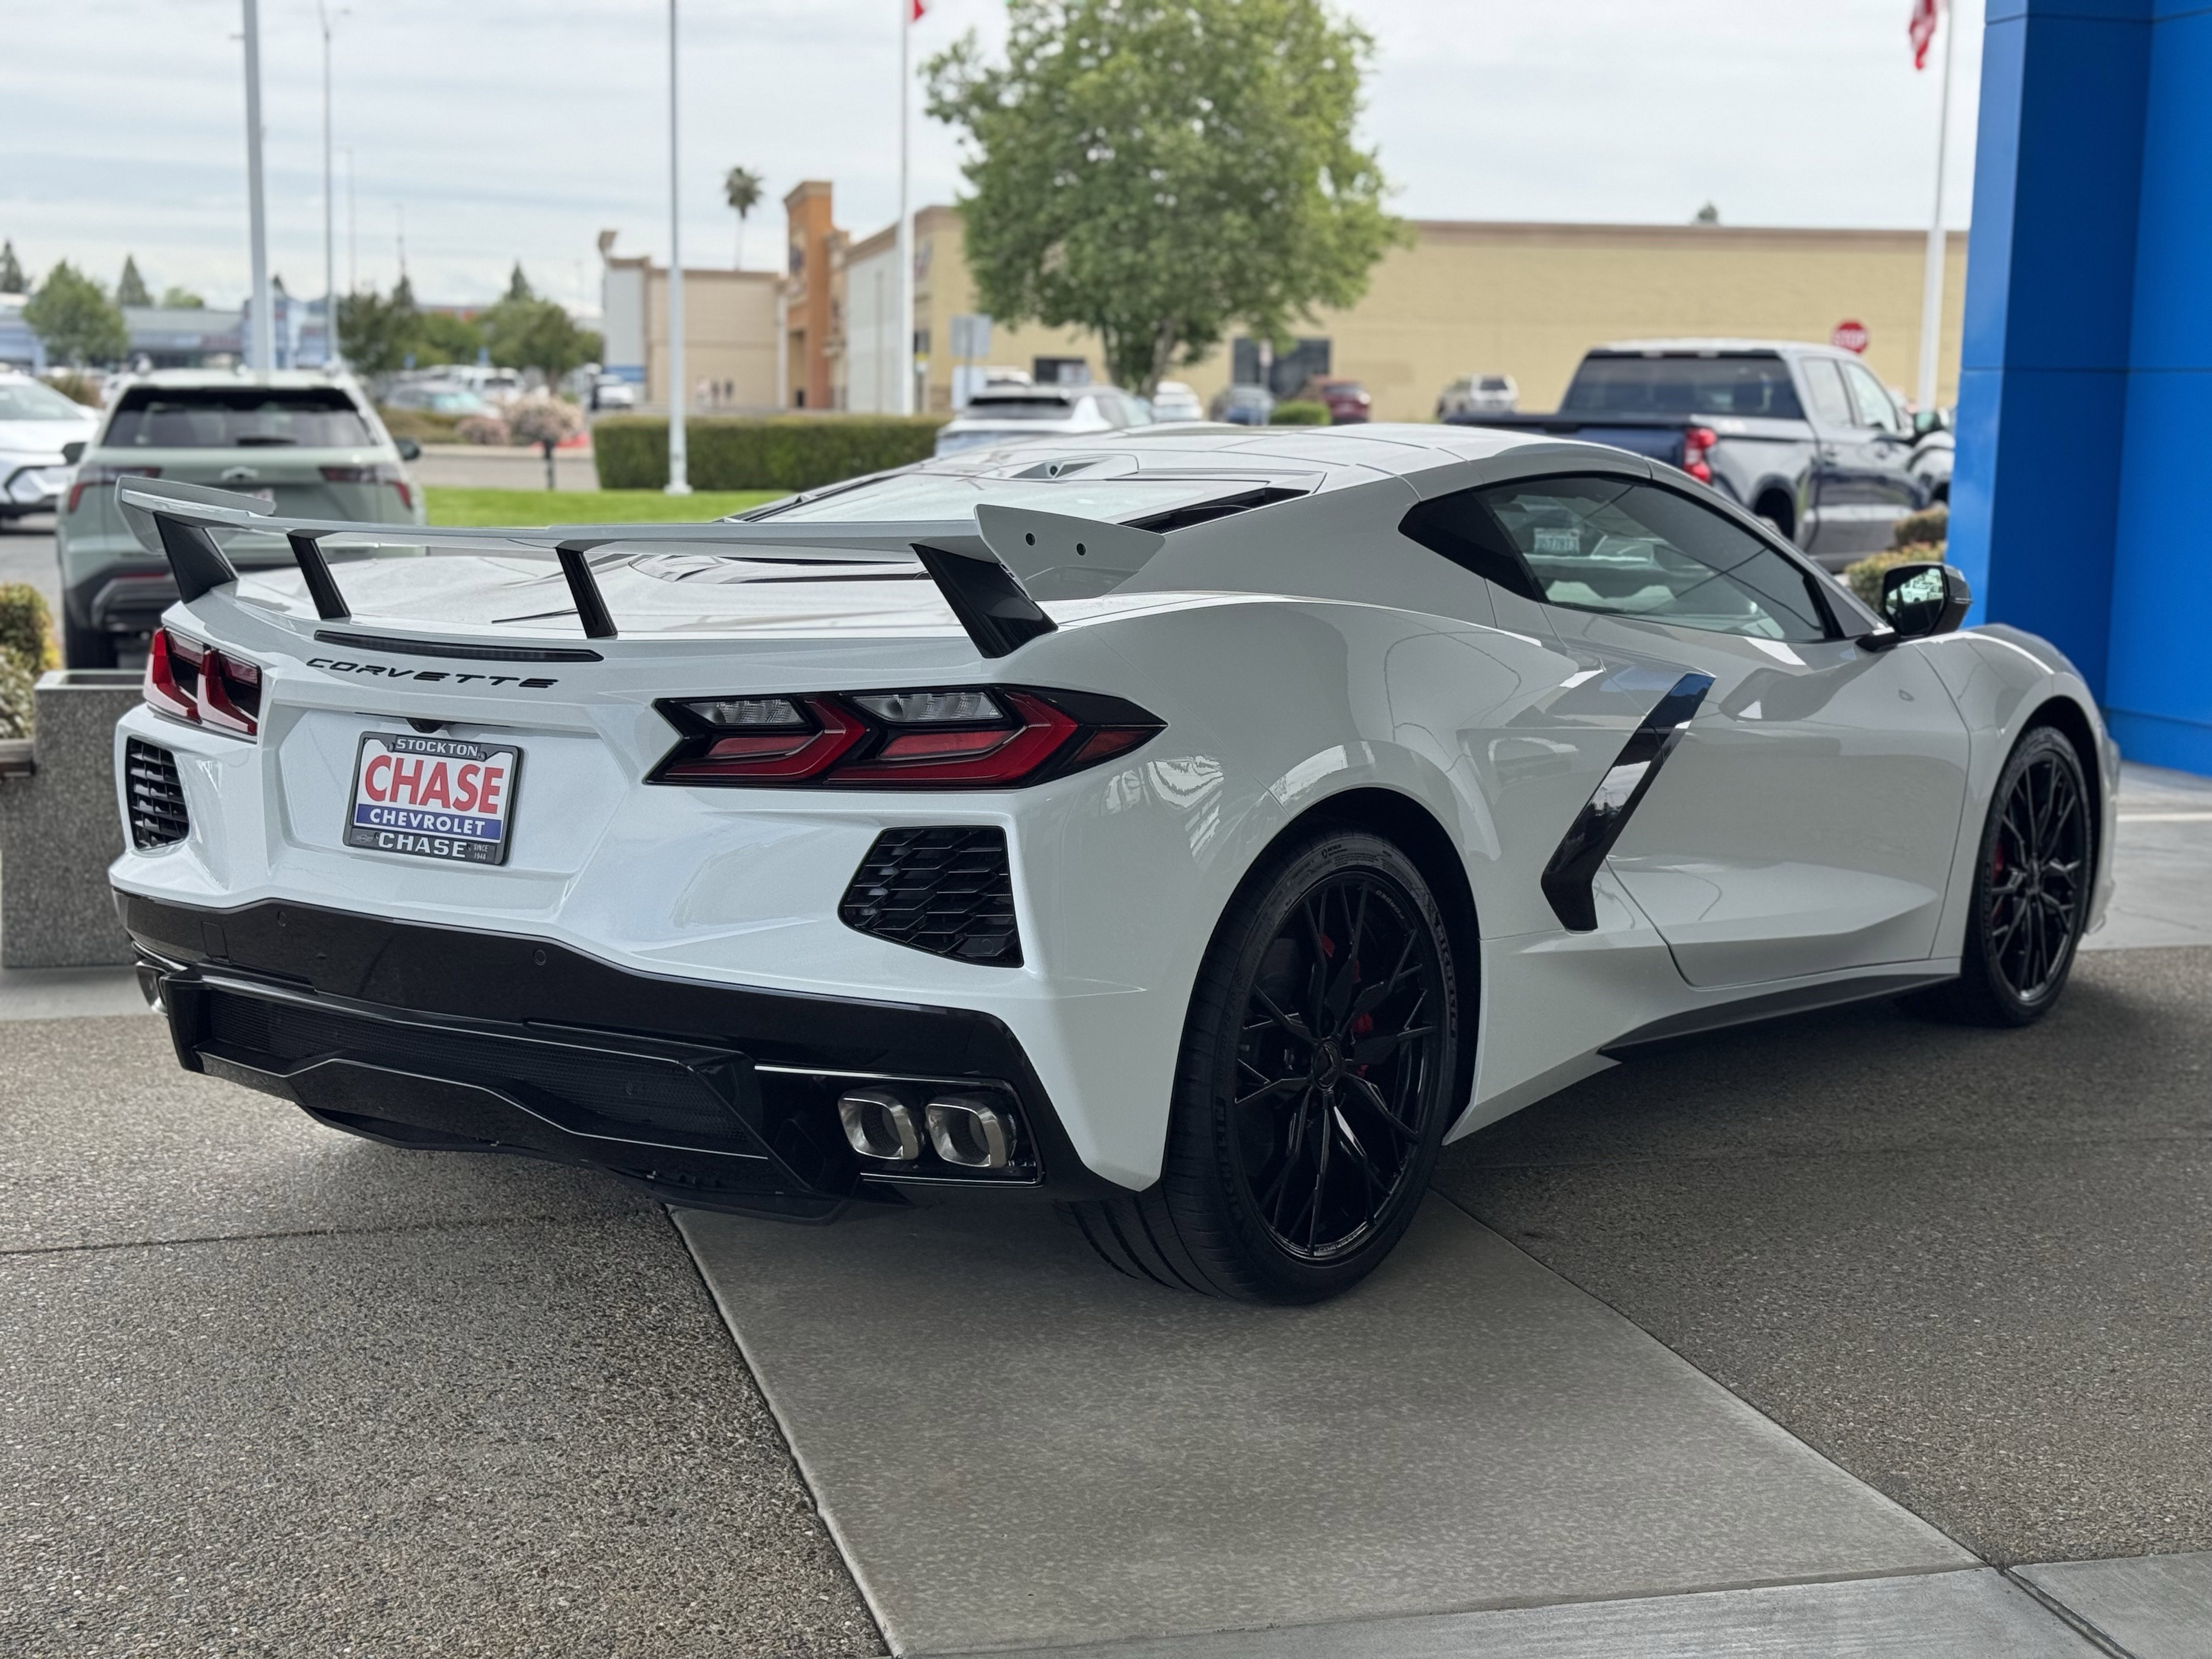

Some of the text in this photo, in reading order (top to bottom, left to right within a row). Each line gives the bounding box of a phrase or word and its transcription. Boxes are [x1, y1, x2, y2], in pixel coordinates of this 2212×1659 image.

[1833, 330, 1866, 346] STOP
[306, 658, 559, 689] CORVETTE
[396, 738, 479, 757] STOCKTON
[365, 754, 504, 815] CHASE
[369, 808, 486, 836] CHEVROLET
[378, 832, 468, 858] CHASE
[473, 843, 489, 853] SINCE
[1436, 924, 1457, 1029] MICHELIN
